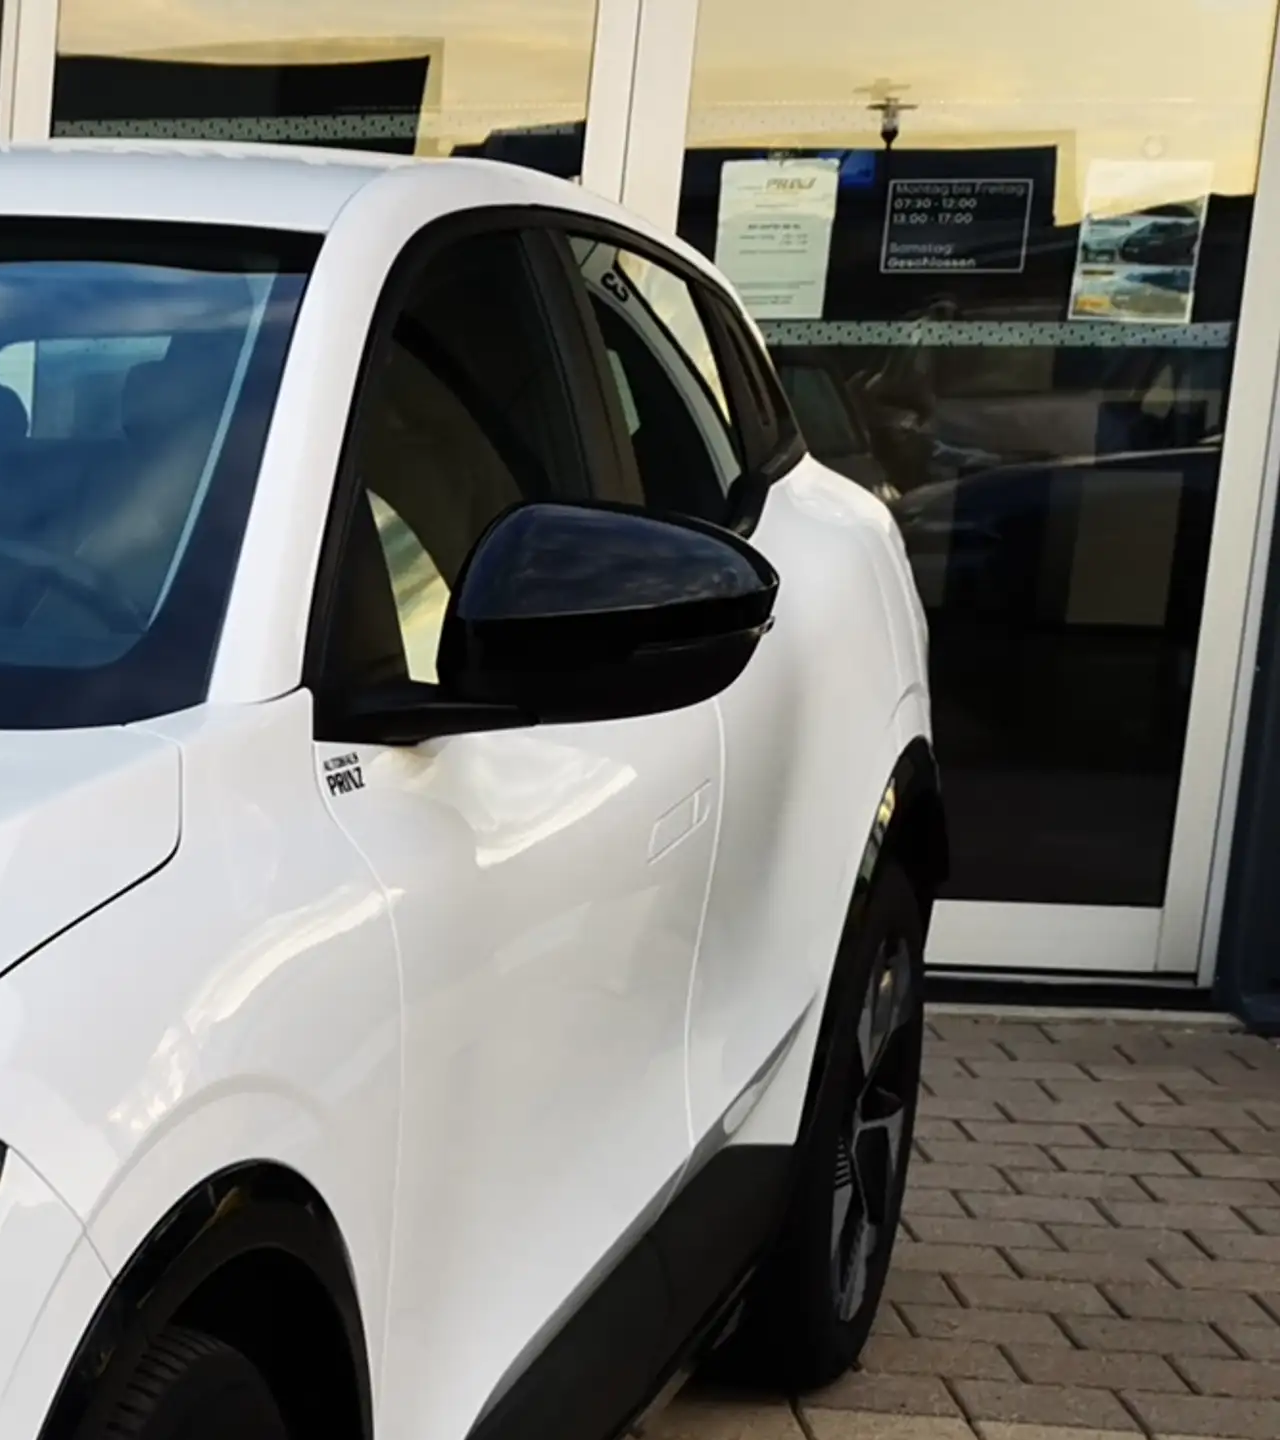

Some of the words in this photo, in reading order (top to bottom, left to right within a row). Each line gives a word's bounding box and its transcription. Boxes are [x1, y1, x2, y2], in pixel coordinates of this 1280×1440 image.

[896, 183, 948, 195] Montag
[974, 182, 1025, 195] Freitag
[890, 242, 953, 255] Samstag
[325, 766, 366, 797] PRINZ
